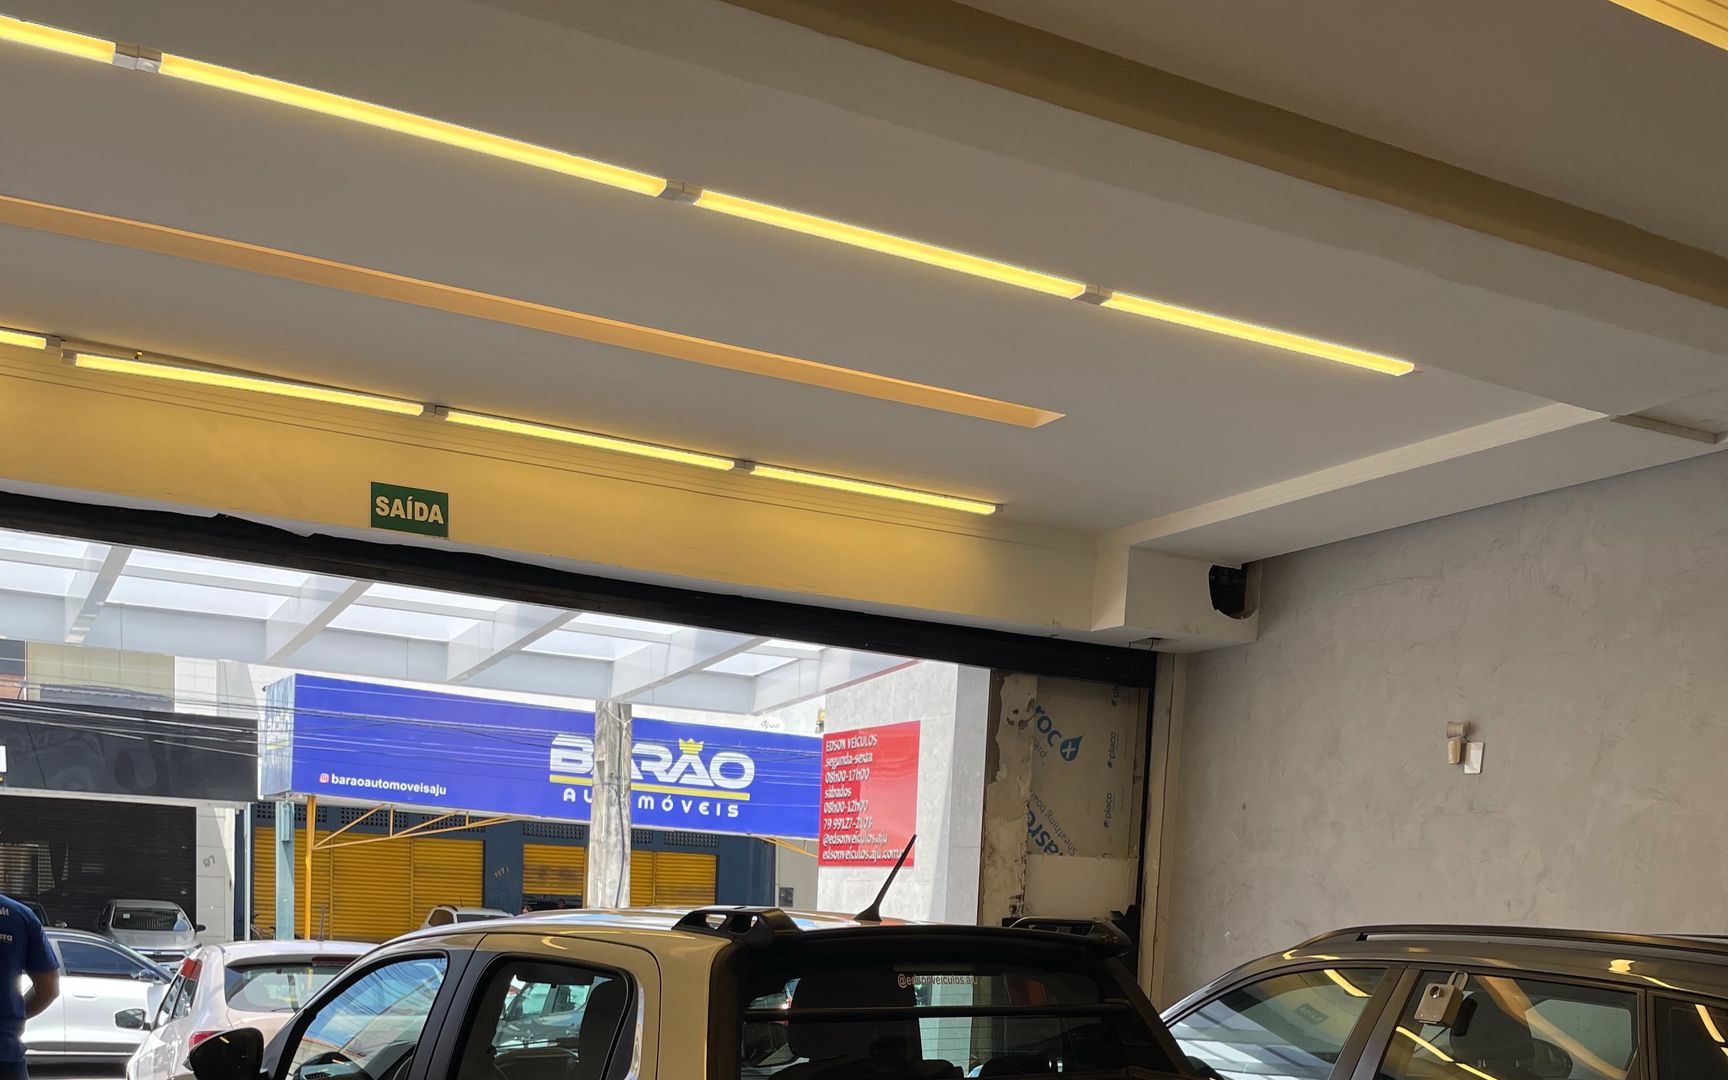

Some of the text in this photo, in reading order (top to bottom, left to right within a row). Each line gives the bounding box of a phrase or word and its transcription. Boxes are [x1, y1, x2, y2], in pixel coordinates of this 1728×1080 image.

[375, 495, 444, 525] SAÍDA
[825, 734, 878, 753] EDSON VEÍCULOS
[331, 773, 447, 797] baraoautomoveisaju
[823, 816, 833, 830] 79
